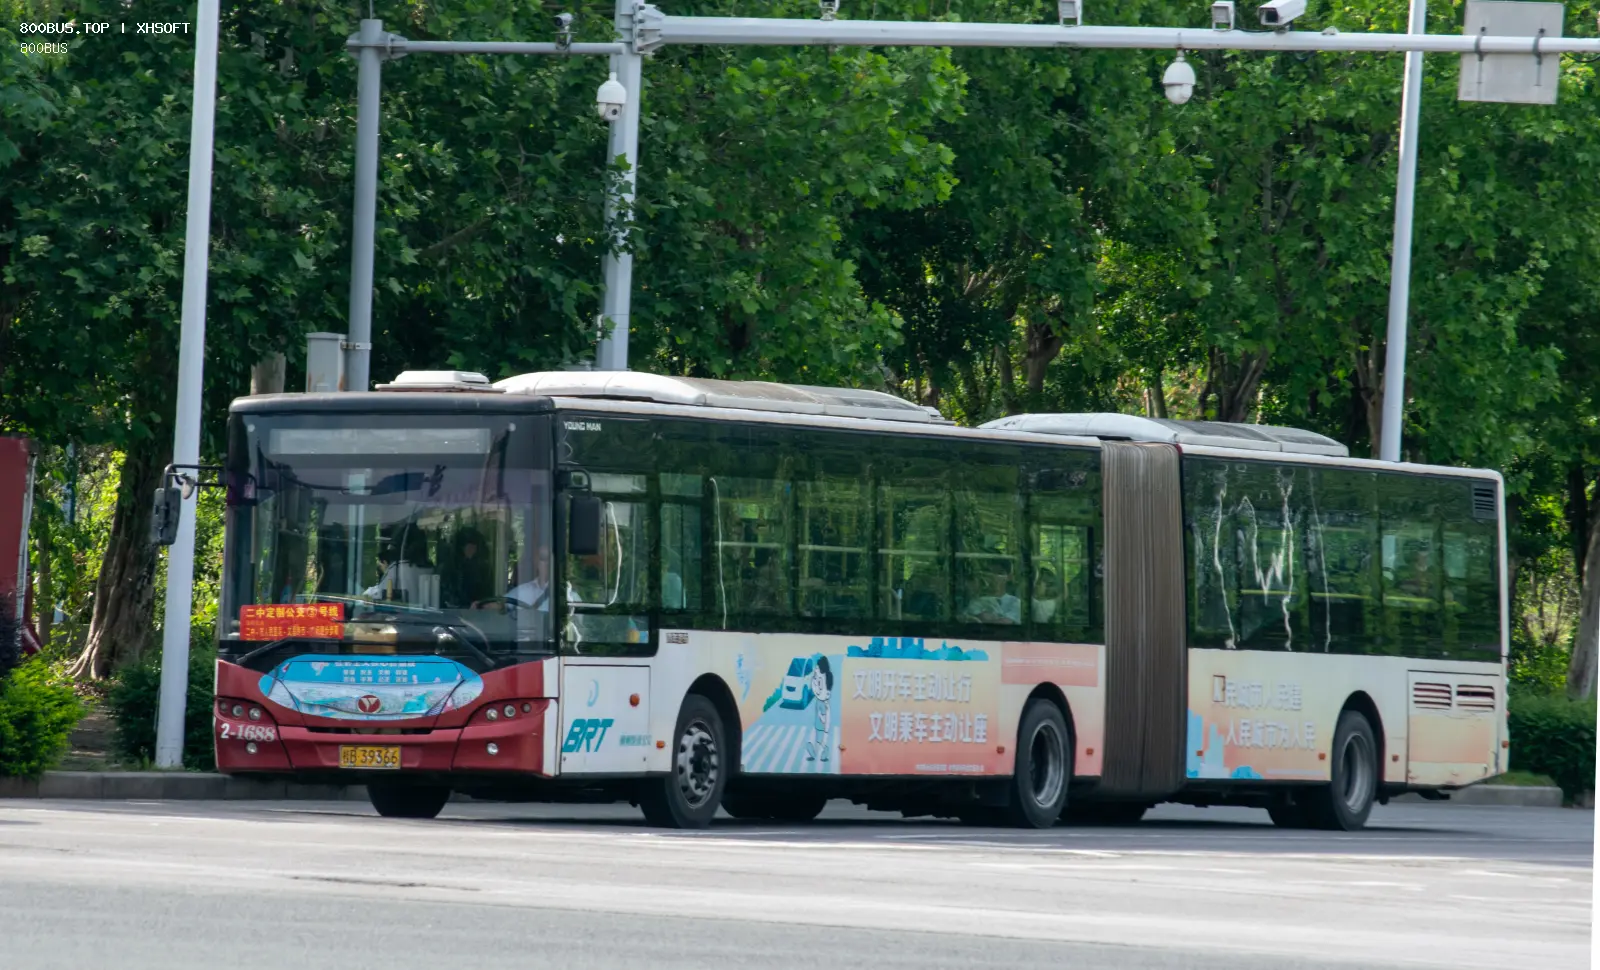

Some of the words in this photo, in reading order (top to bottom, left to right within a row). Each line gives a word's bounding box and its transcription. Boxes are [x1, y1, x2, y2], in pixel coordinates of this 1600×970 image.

[563, 421, 586, 431] YOUNG
[586, 422, 602, 432] MAN
[853, 669, 972, 704] 文明开车主动让行
[220, 722, 276, 742] 2-1688
[562, 718, 615, 753] BRT
[868, 711, 988, 744] 文明乘车主动让座
